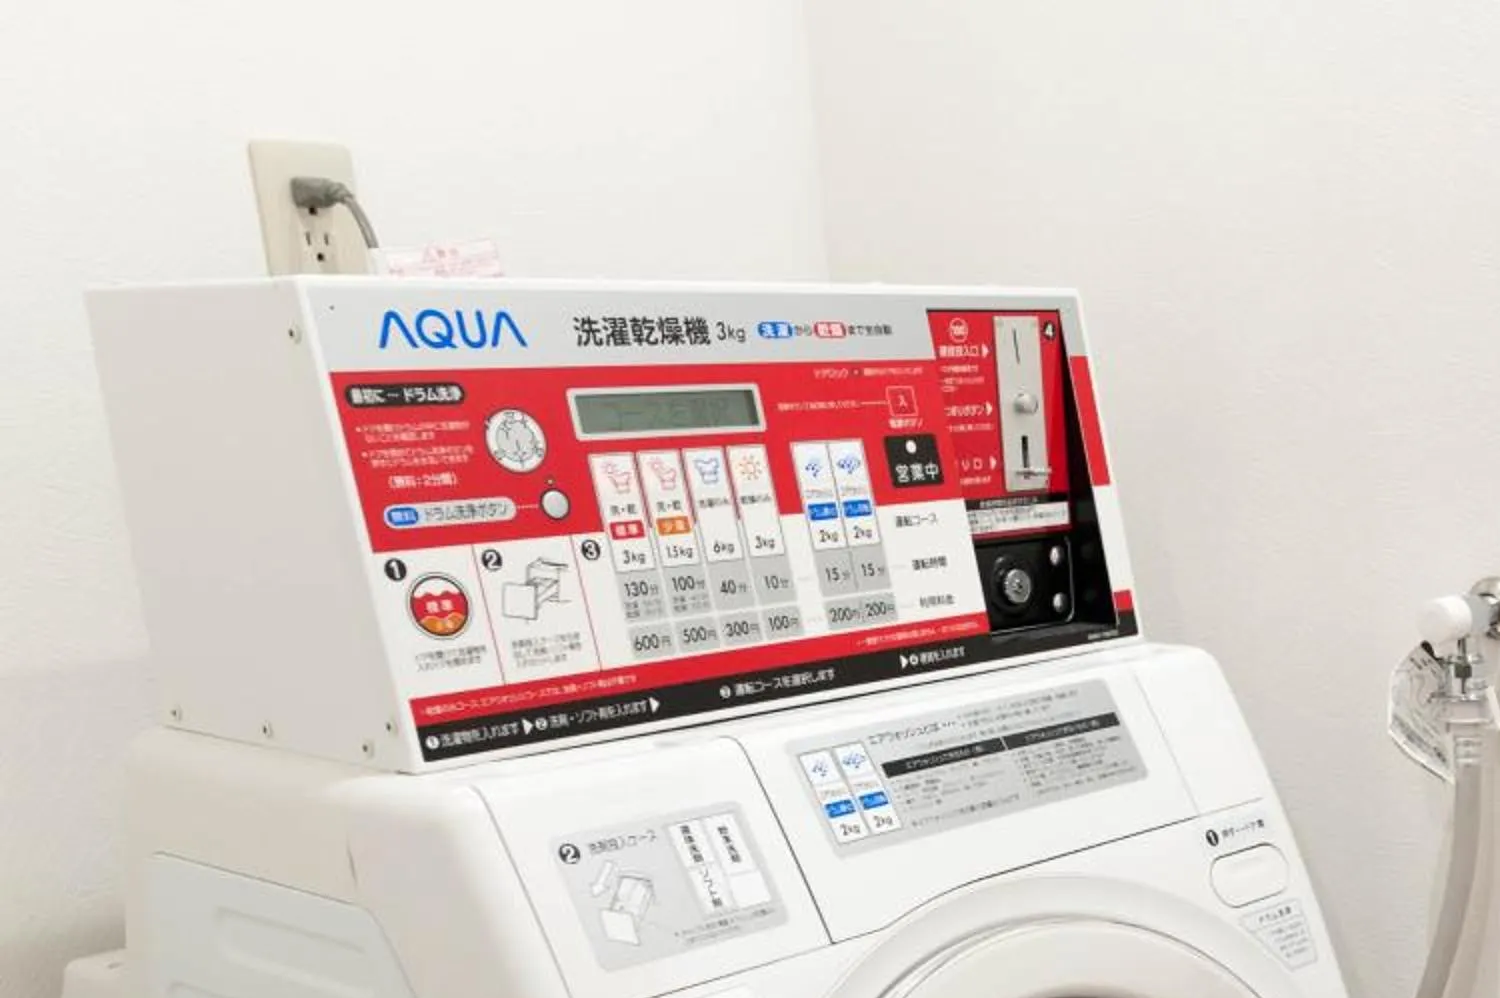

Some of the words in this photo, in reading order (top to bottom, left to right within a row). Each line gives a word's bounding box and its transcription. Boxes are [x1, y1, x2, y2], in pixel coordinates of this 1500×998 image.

[378, 308, 528, 349] AQUA
[574, 316, 711, 347] 洗濯乾燥機
[716, 321, 746, 343] 3kg
[1042, 322, 1055, 339] 4
[895, 462, 939, 483] 営業中
[582, 540, 600, 560] 3
[713, 540, 735, 554] 6kg
[755, 535, 776, 549] 3kg
[482, 550, 502, 570] 2
[623, 550, 646, 565] 3kg
[559, 843, 581, 865] 2
